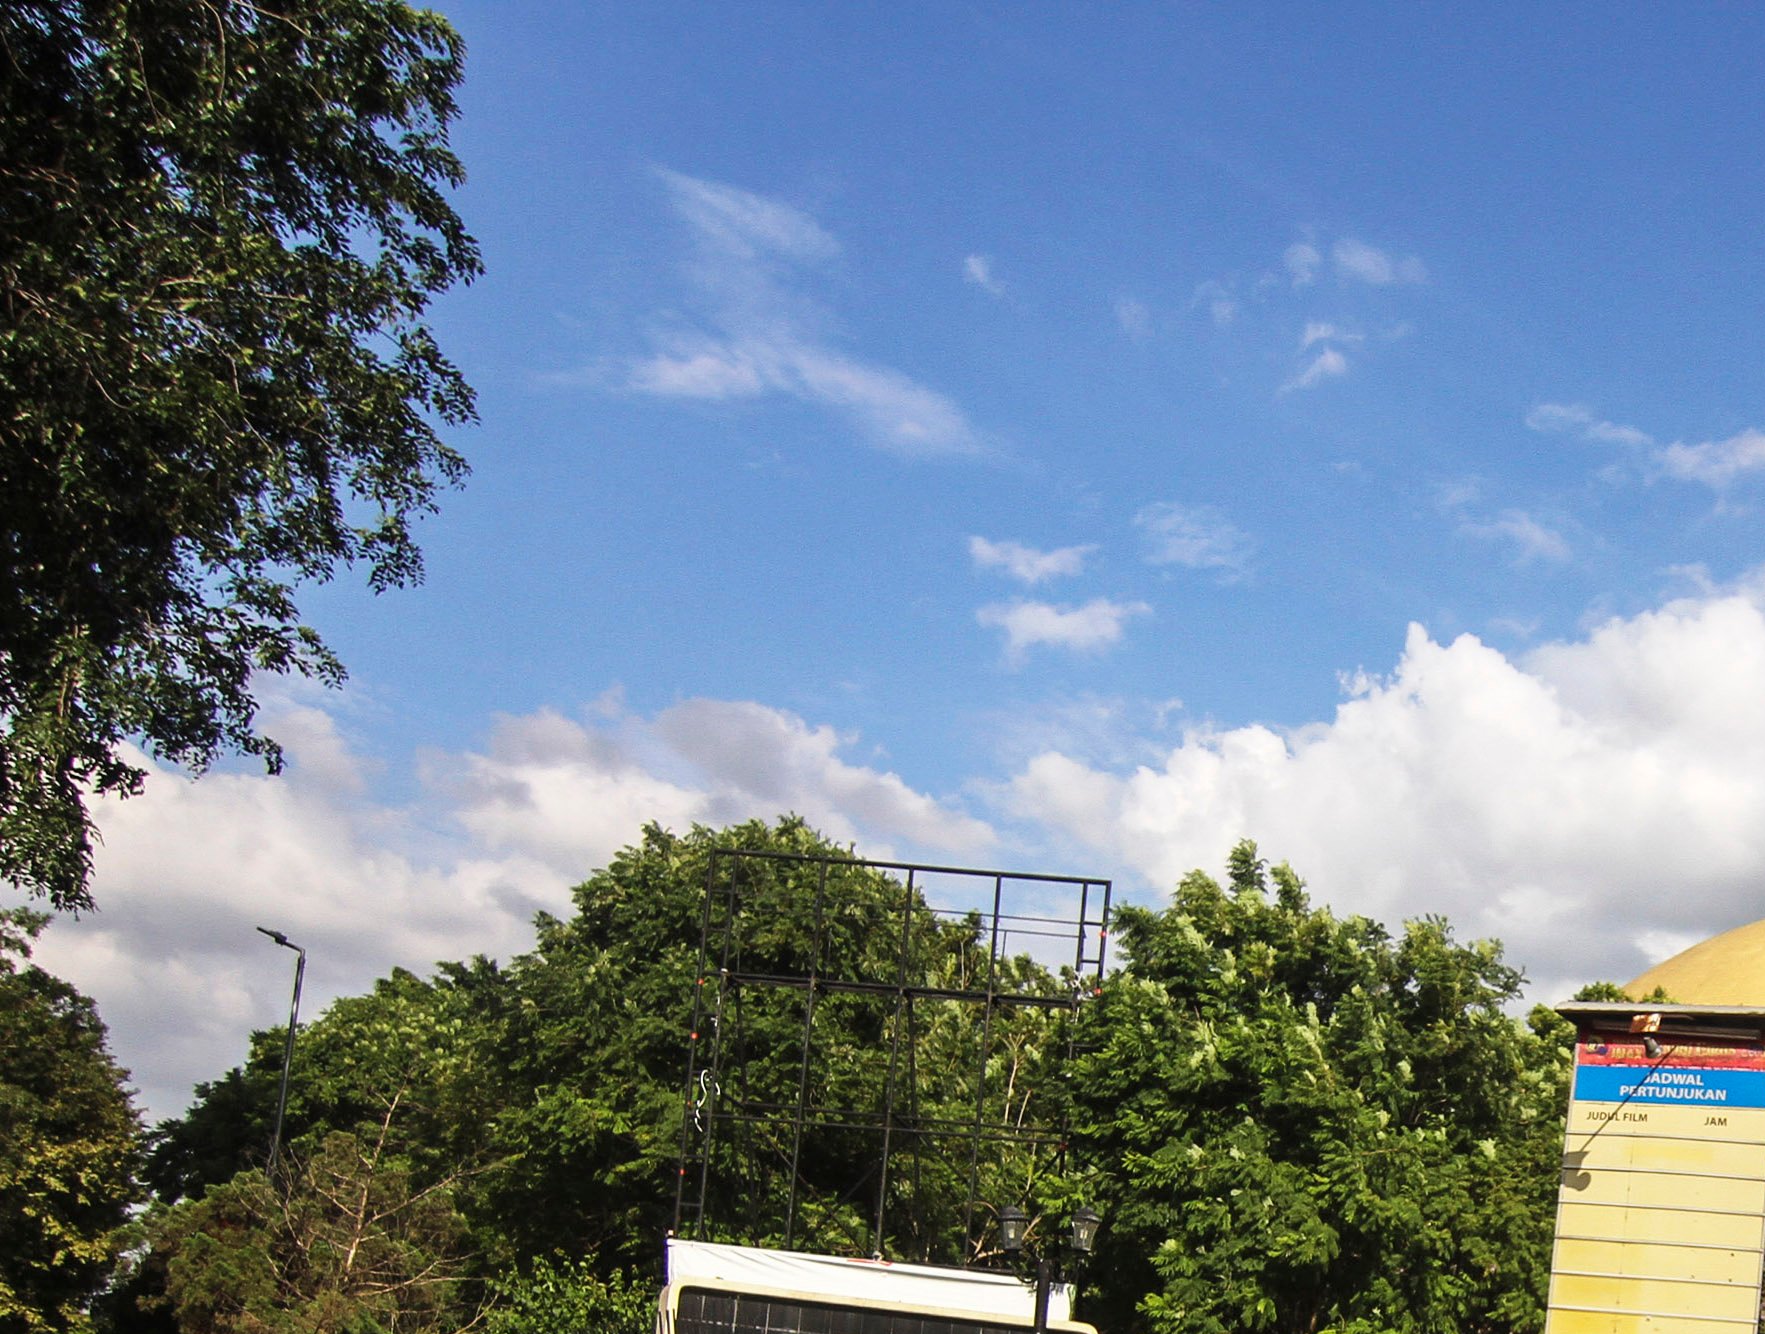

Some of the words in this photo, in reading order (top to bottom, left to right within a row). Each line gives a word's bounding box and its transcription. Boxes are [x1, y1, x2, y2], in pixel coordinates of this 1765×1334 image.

[1644, 1072, 1704, 1086] JADWAL
[1619, 1085, 1727, 1101] PERTUNJUKAN
[1586, 1111, 1620, 1122] JUDUL
[1622, 1112, 1648, 1123] FILM
[1703, 1117, 1728, 1127] JAM
